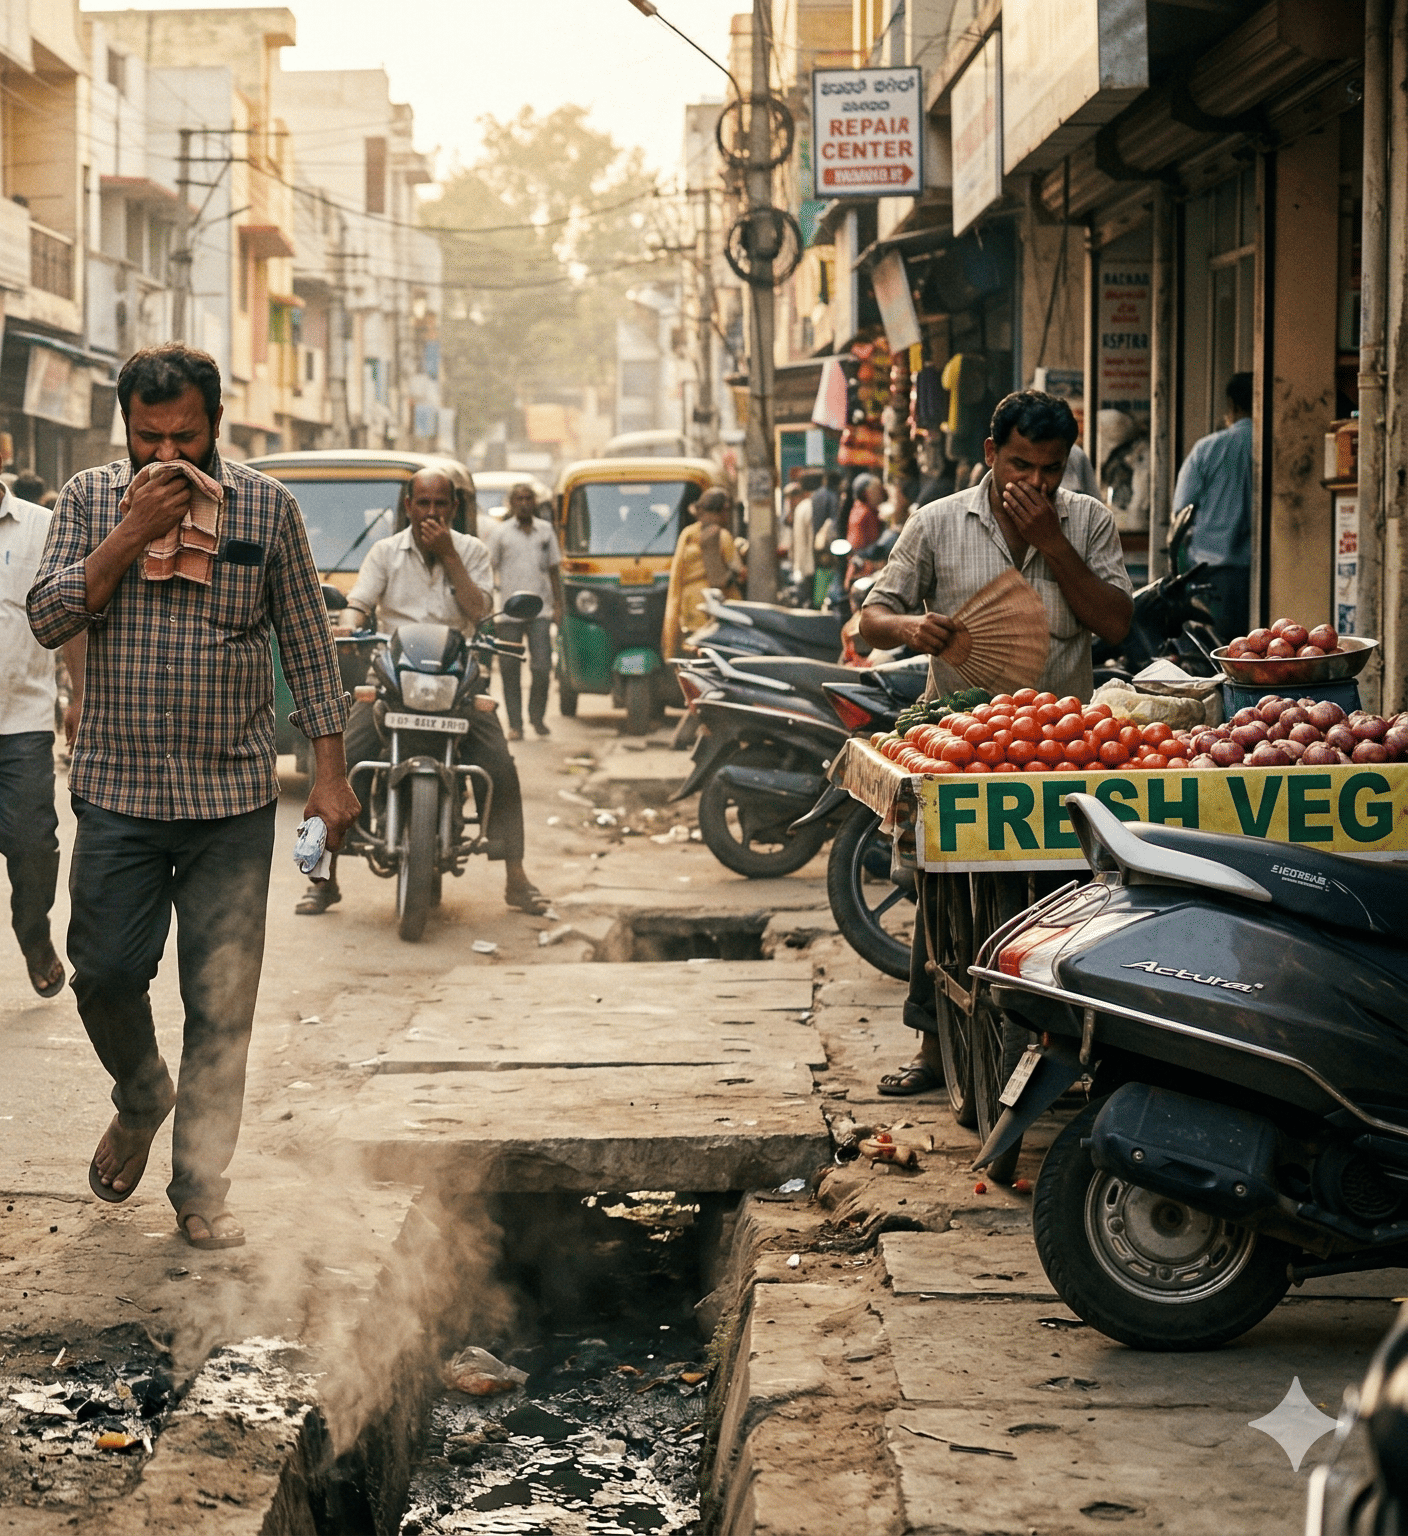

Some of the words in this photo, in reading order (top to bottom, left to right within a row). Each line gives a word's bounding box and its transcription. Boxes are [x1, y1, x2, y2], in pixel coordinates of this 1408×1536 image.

[829, 117, 910, 137] REPAIR
[821, 140, 913, 160] CENTER
[938, 779, 1199, 852] FRESH
[1227, 772, 1392, 843] VEG
